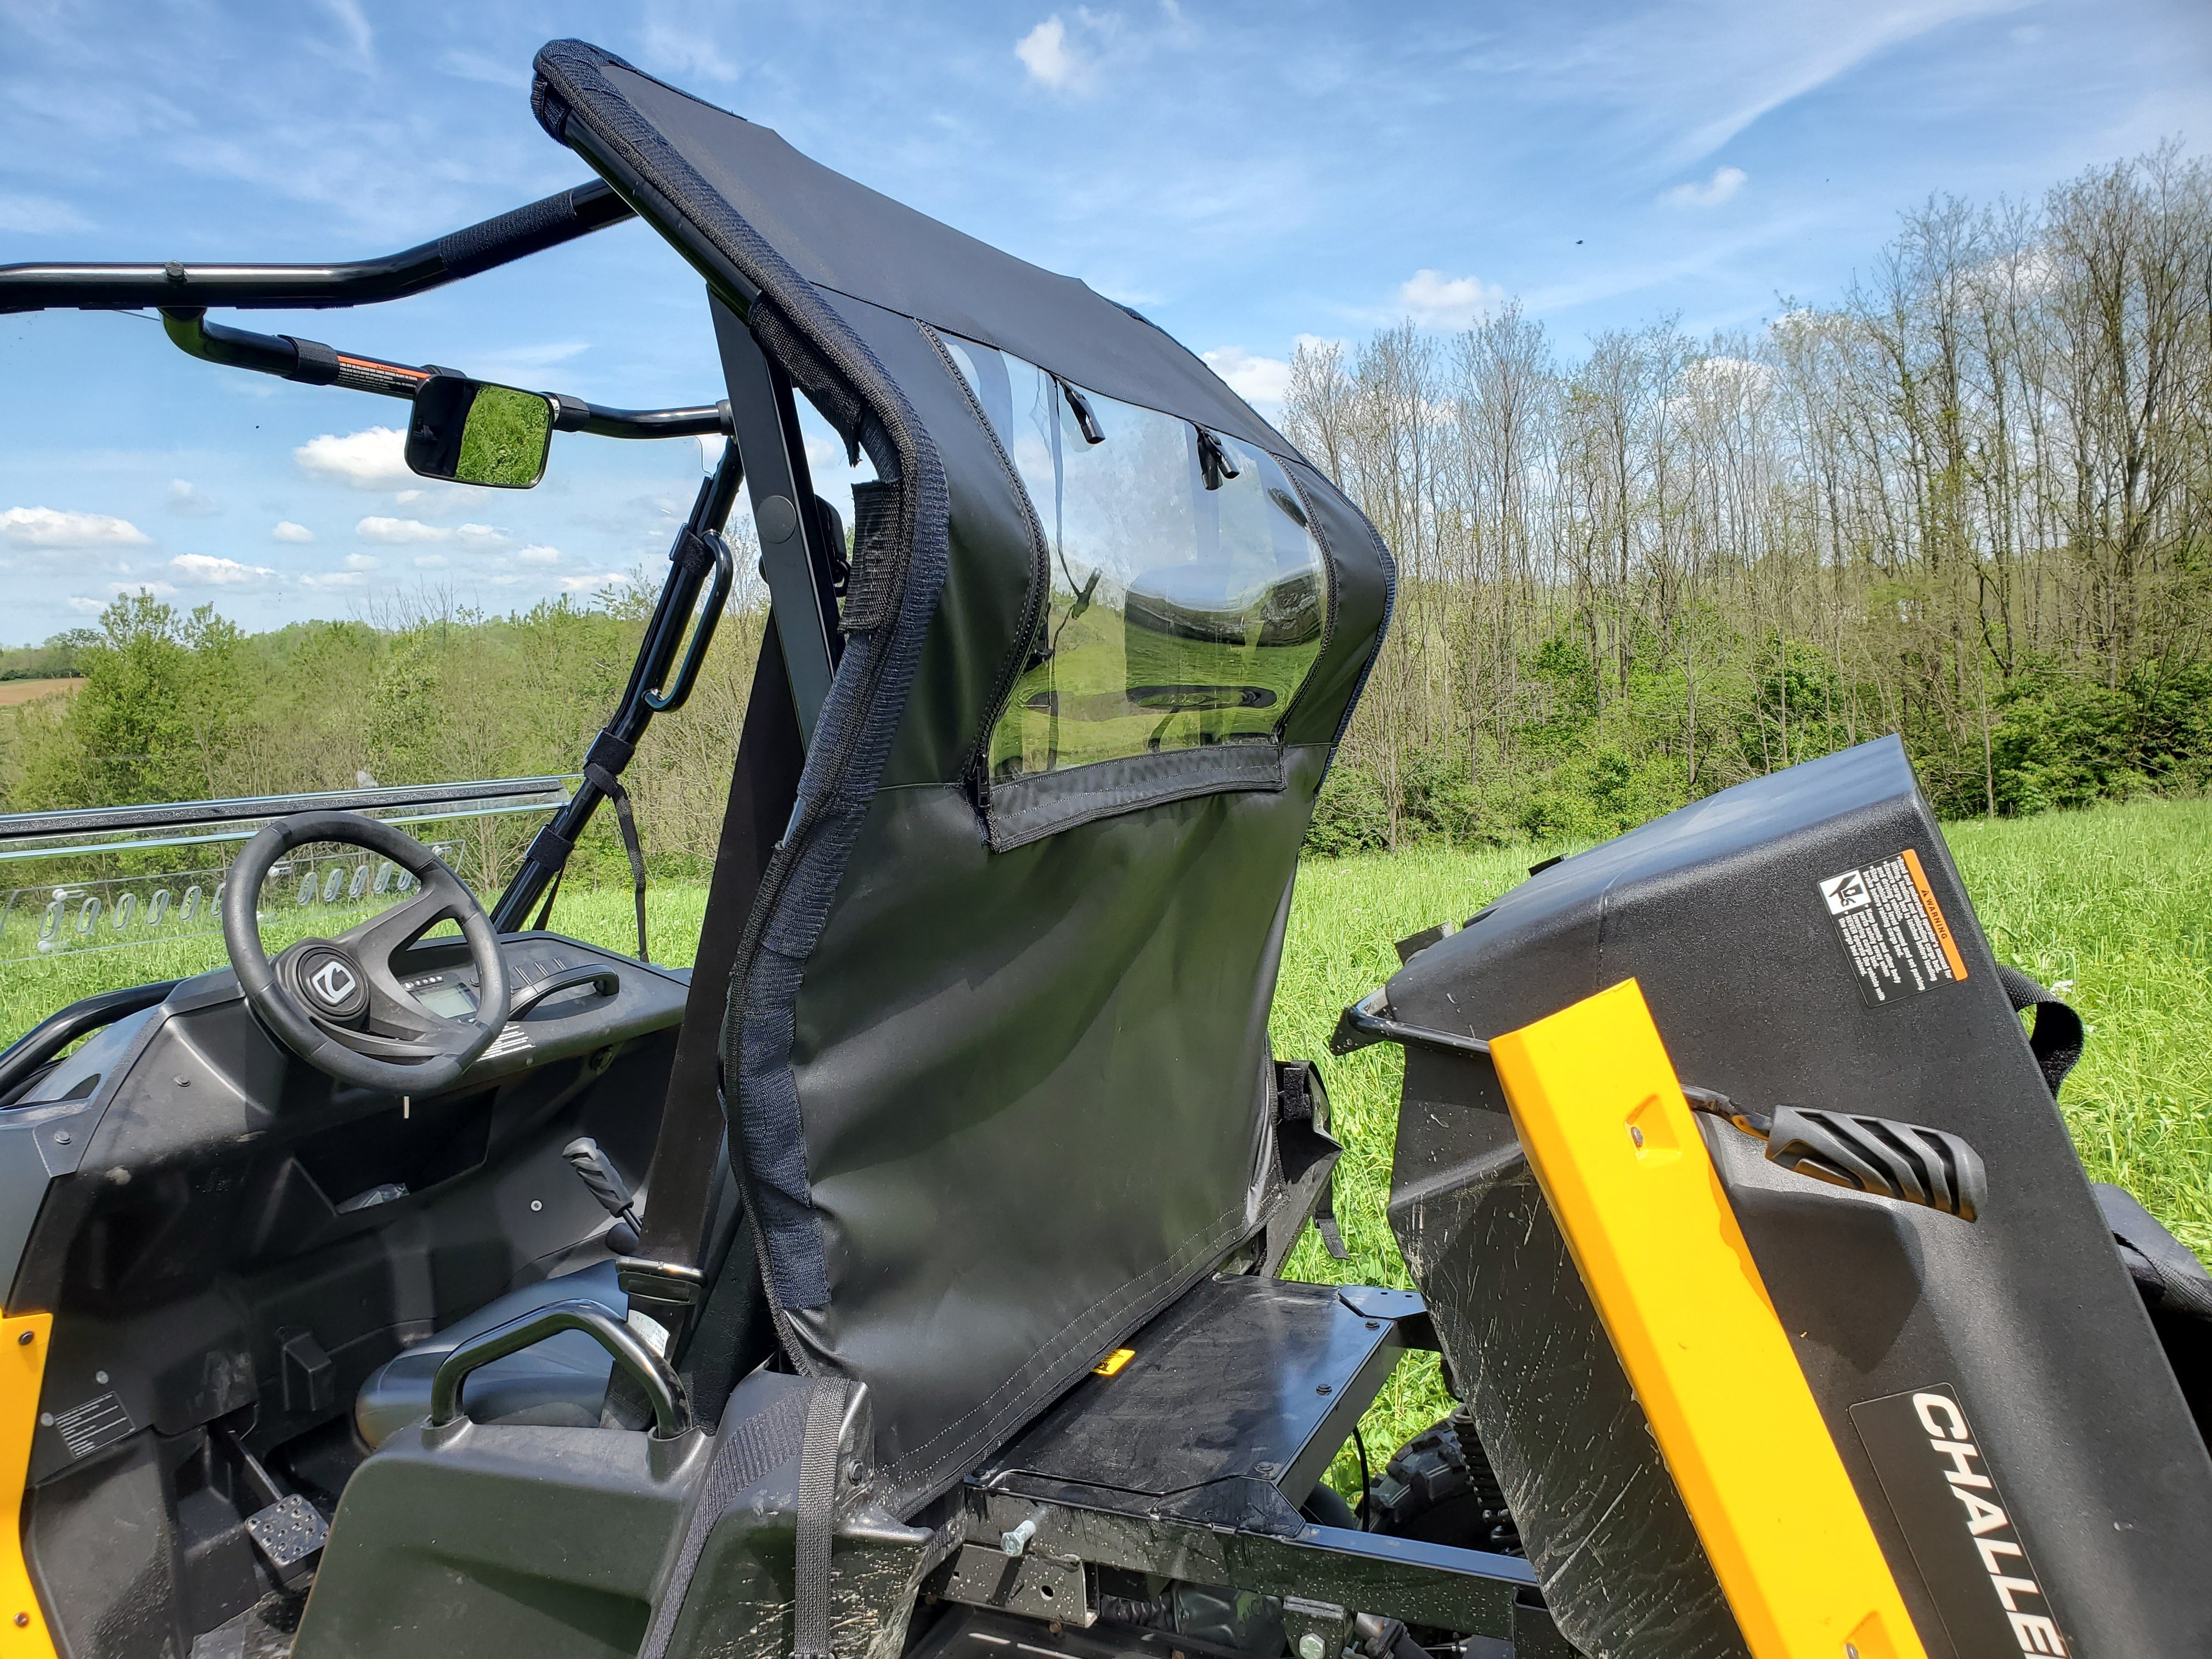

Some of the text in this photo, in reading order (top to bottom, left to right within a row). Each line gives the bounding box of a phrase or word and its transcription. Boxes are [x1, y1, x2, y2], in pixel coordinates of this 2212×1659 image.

[1868, 868, 1879, 882] Stop
[1875, 882, 1888, 902] vehicle
[1876, 866, 1903, 921] and driving vehicle.
[1850, 912, 1879, 968] lowering cargo bed.
[1862, 870, 1904, 958] brake before raising cargo bed.
[1883, 863, 1896, 883] Ensure
[1891, 884, 1903, 900] cargo
[1898, 900, 1909, 912] bed
[1906, 918, 1921, 940] latched
[1915, 940, 1928, 959] before
[1923, 959, 1937, 981] loading
[1887, 911, 1899, 926] level
[1888, 861, 1942, 973] lifting, loading and unloading cargo bed.
[1893, 926, 1908, 946] ground
[1897, 858, 1952, 978] Read and understand operator's manual for
[1926, 899, 1947, 939] WARNING
[1838, 917, 1867, 976] the cargo bed raised.
[1844, 915, 1885, 1001] NEVER operate the vehicle with
[1857, 911, 1890, 977] parts safely away when
[1864, 908, 1901, 983] Keep hands and other body
[1902, 946, 1912, 958] and
[1908, 958, 1916, 968] set
[1910, 968, 1925, 990] parking
[1912, 1393, 2068, 1659] CHALLE
